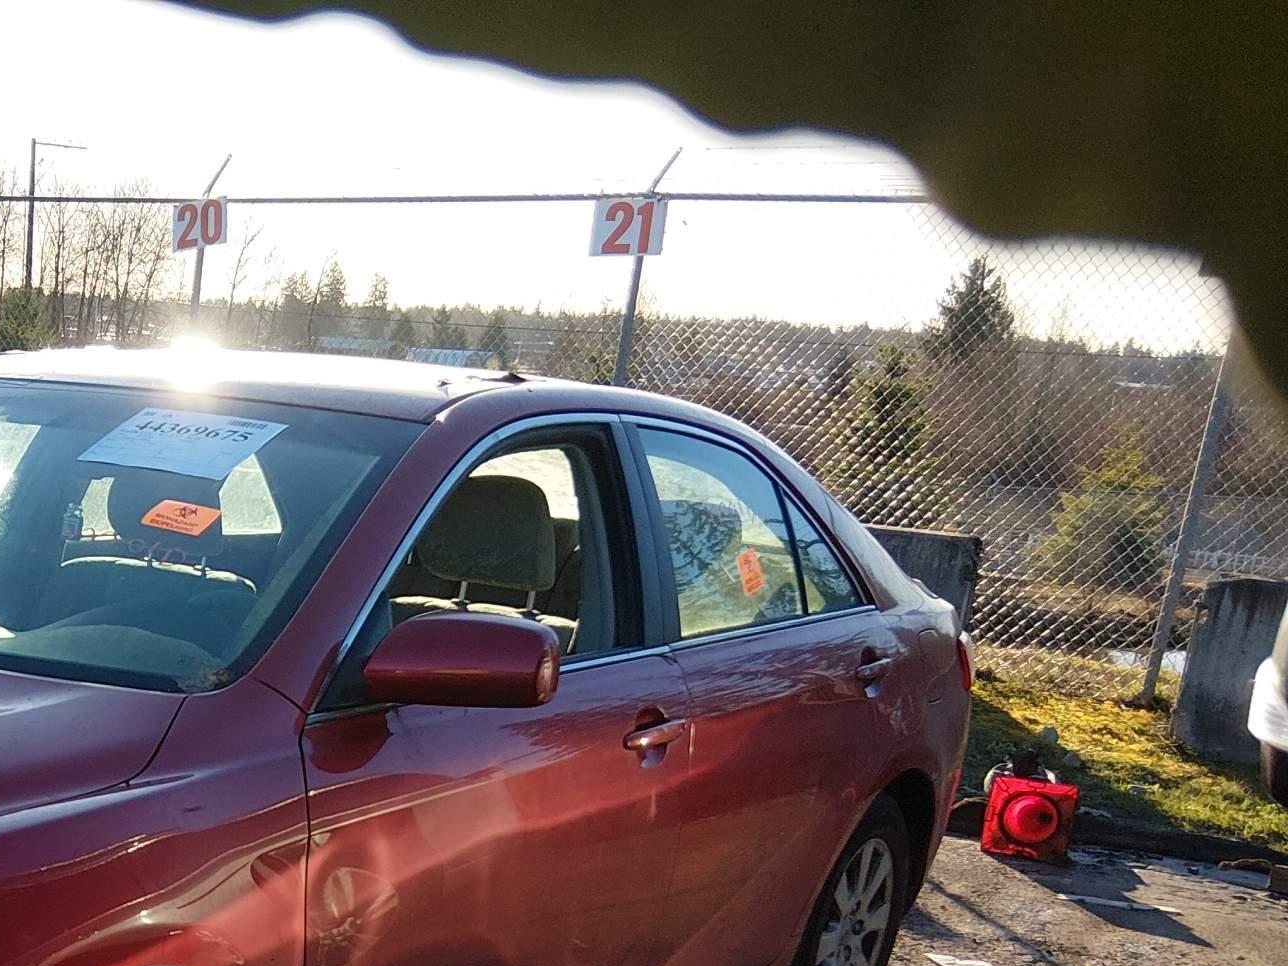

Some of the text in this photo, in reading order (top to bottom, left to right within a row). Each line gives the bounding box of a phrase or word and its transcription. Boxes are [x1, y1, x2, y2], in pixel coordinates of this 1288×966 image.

[177, 199, 223, 249] 20
[601, 201, 655, 254] 21
[135, 419, 256, 443] 44369675
